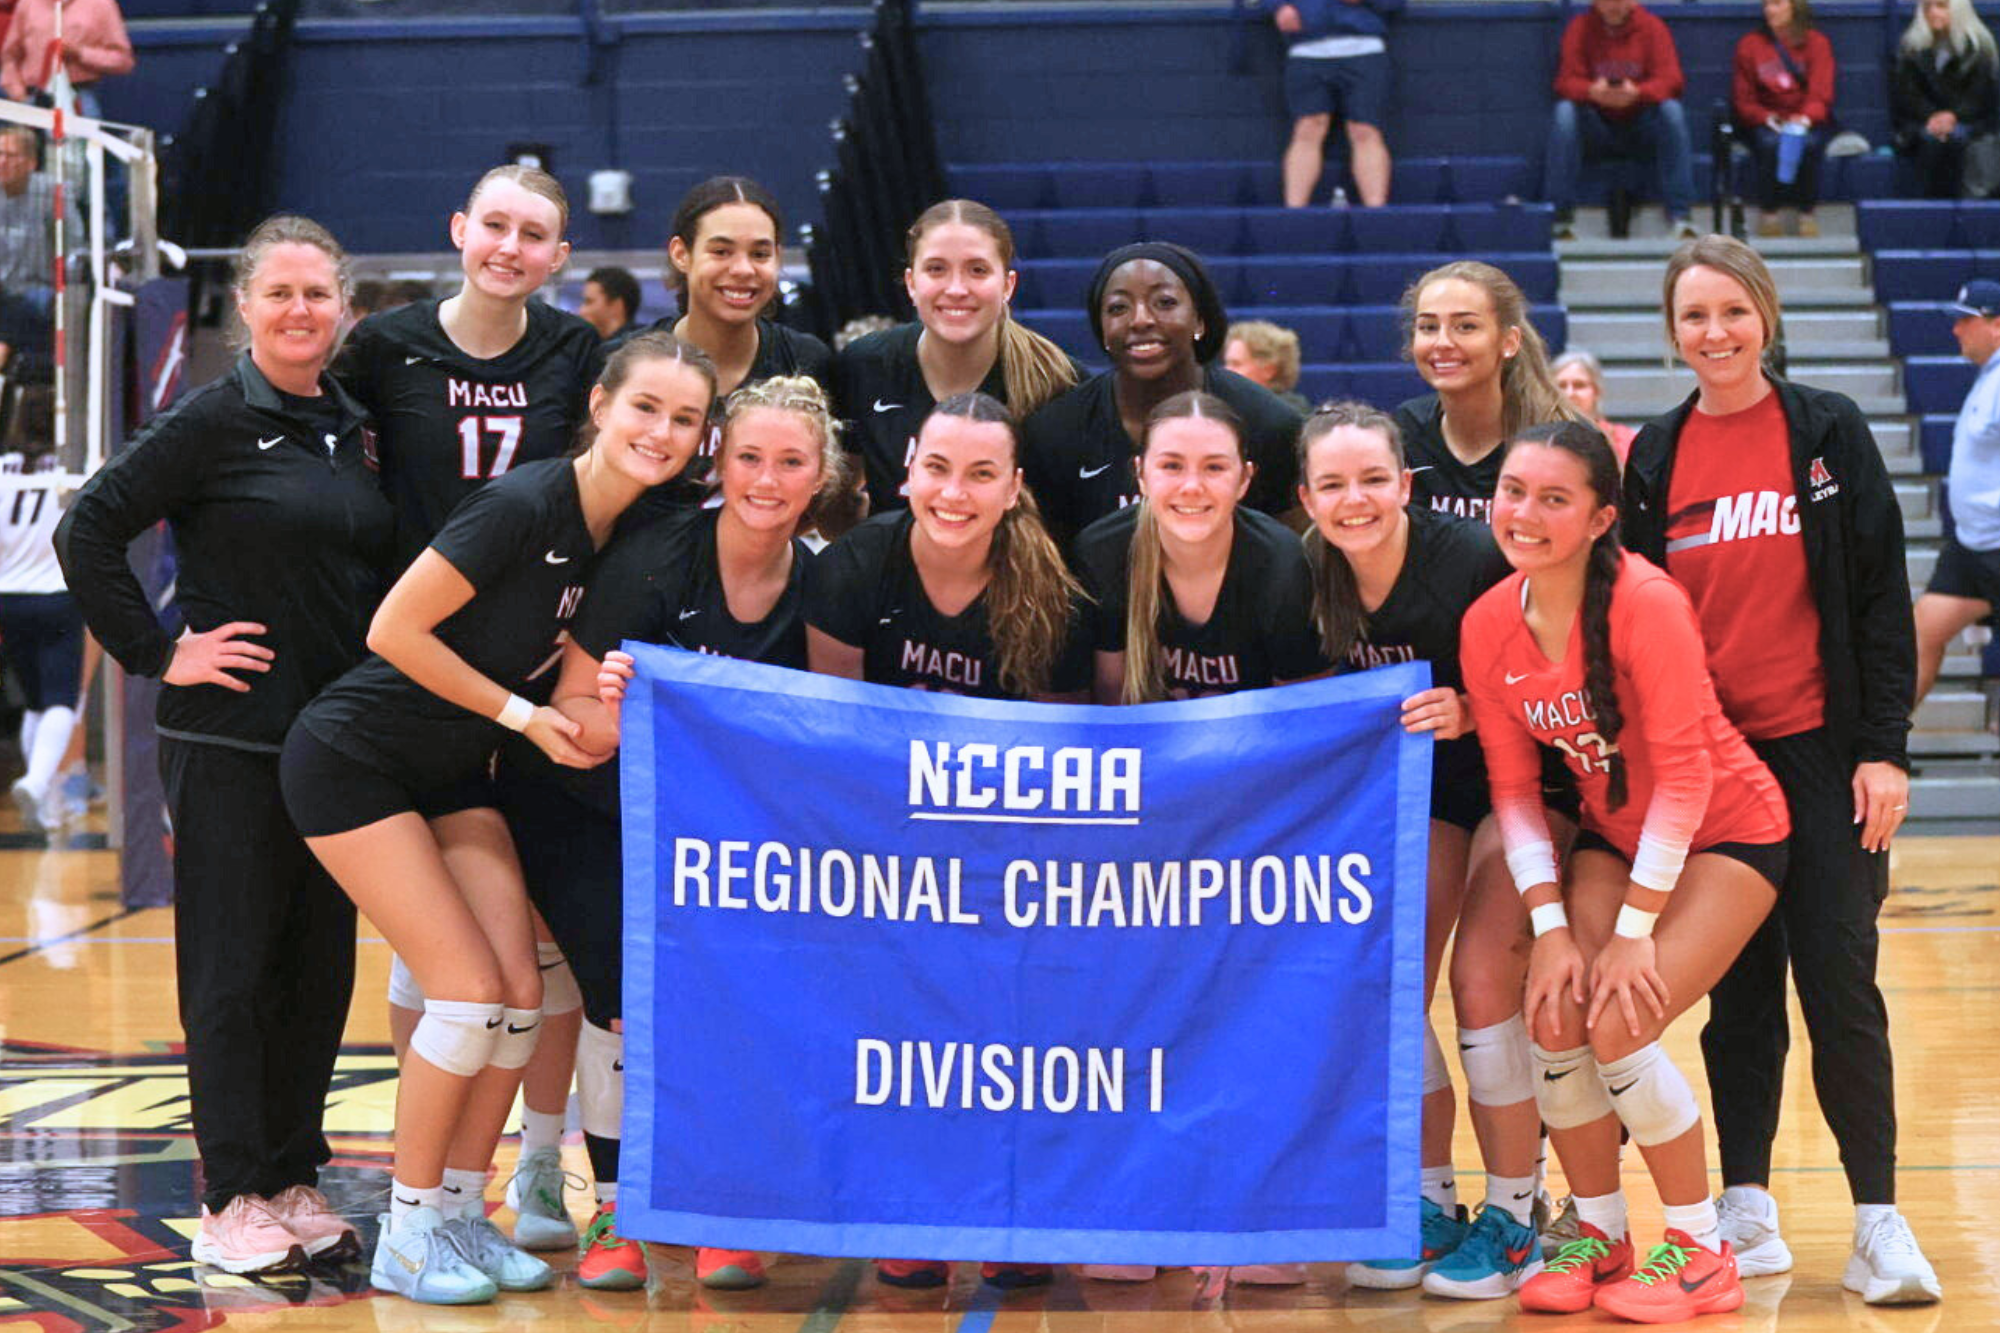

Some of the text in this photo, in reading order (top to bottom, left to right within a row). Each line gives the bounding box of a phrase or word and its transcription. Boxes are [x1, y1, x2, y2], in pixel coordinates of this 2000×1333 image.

[447, 378, 528, 408] MACU
[456, 415, 524, 480] 17
[10, 487, 48, 526] 17
[902, 639, 981, 687] MACU
[1161, 646, 1240, 685] MACU
[1523, 690, 1598, 731] MACU
[908, 739, 1142, 812] NCCAA
[673, 837, 1374, 929] REGIONAL CHAMPIONS
[855, 1038, 1164, 1113] DIVISION I
